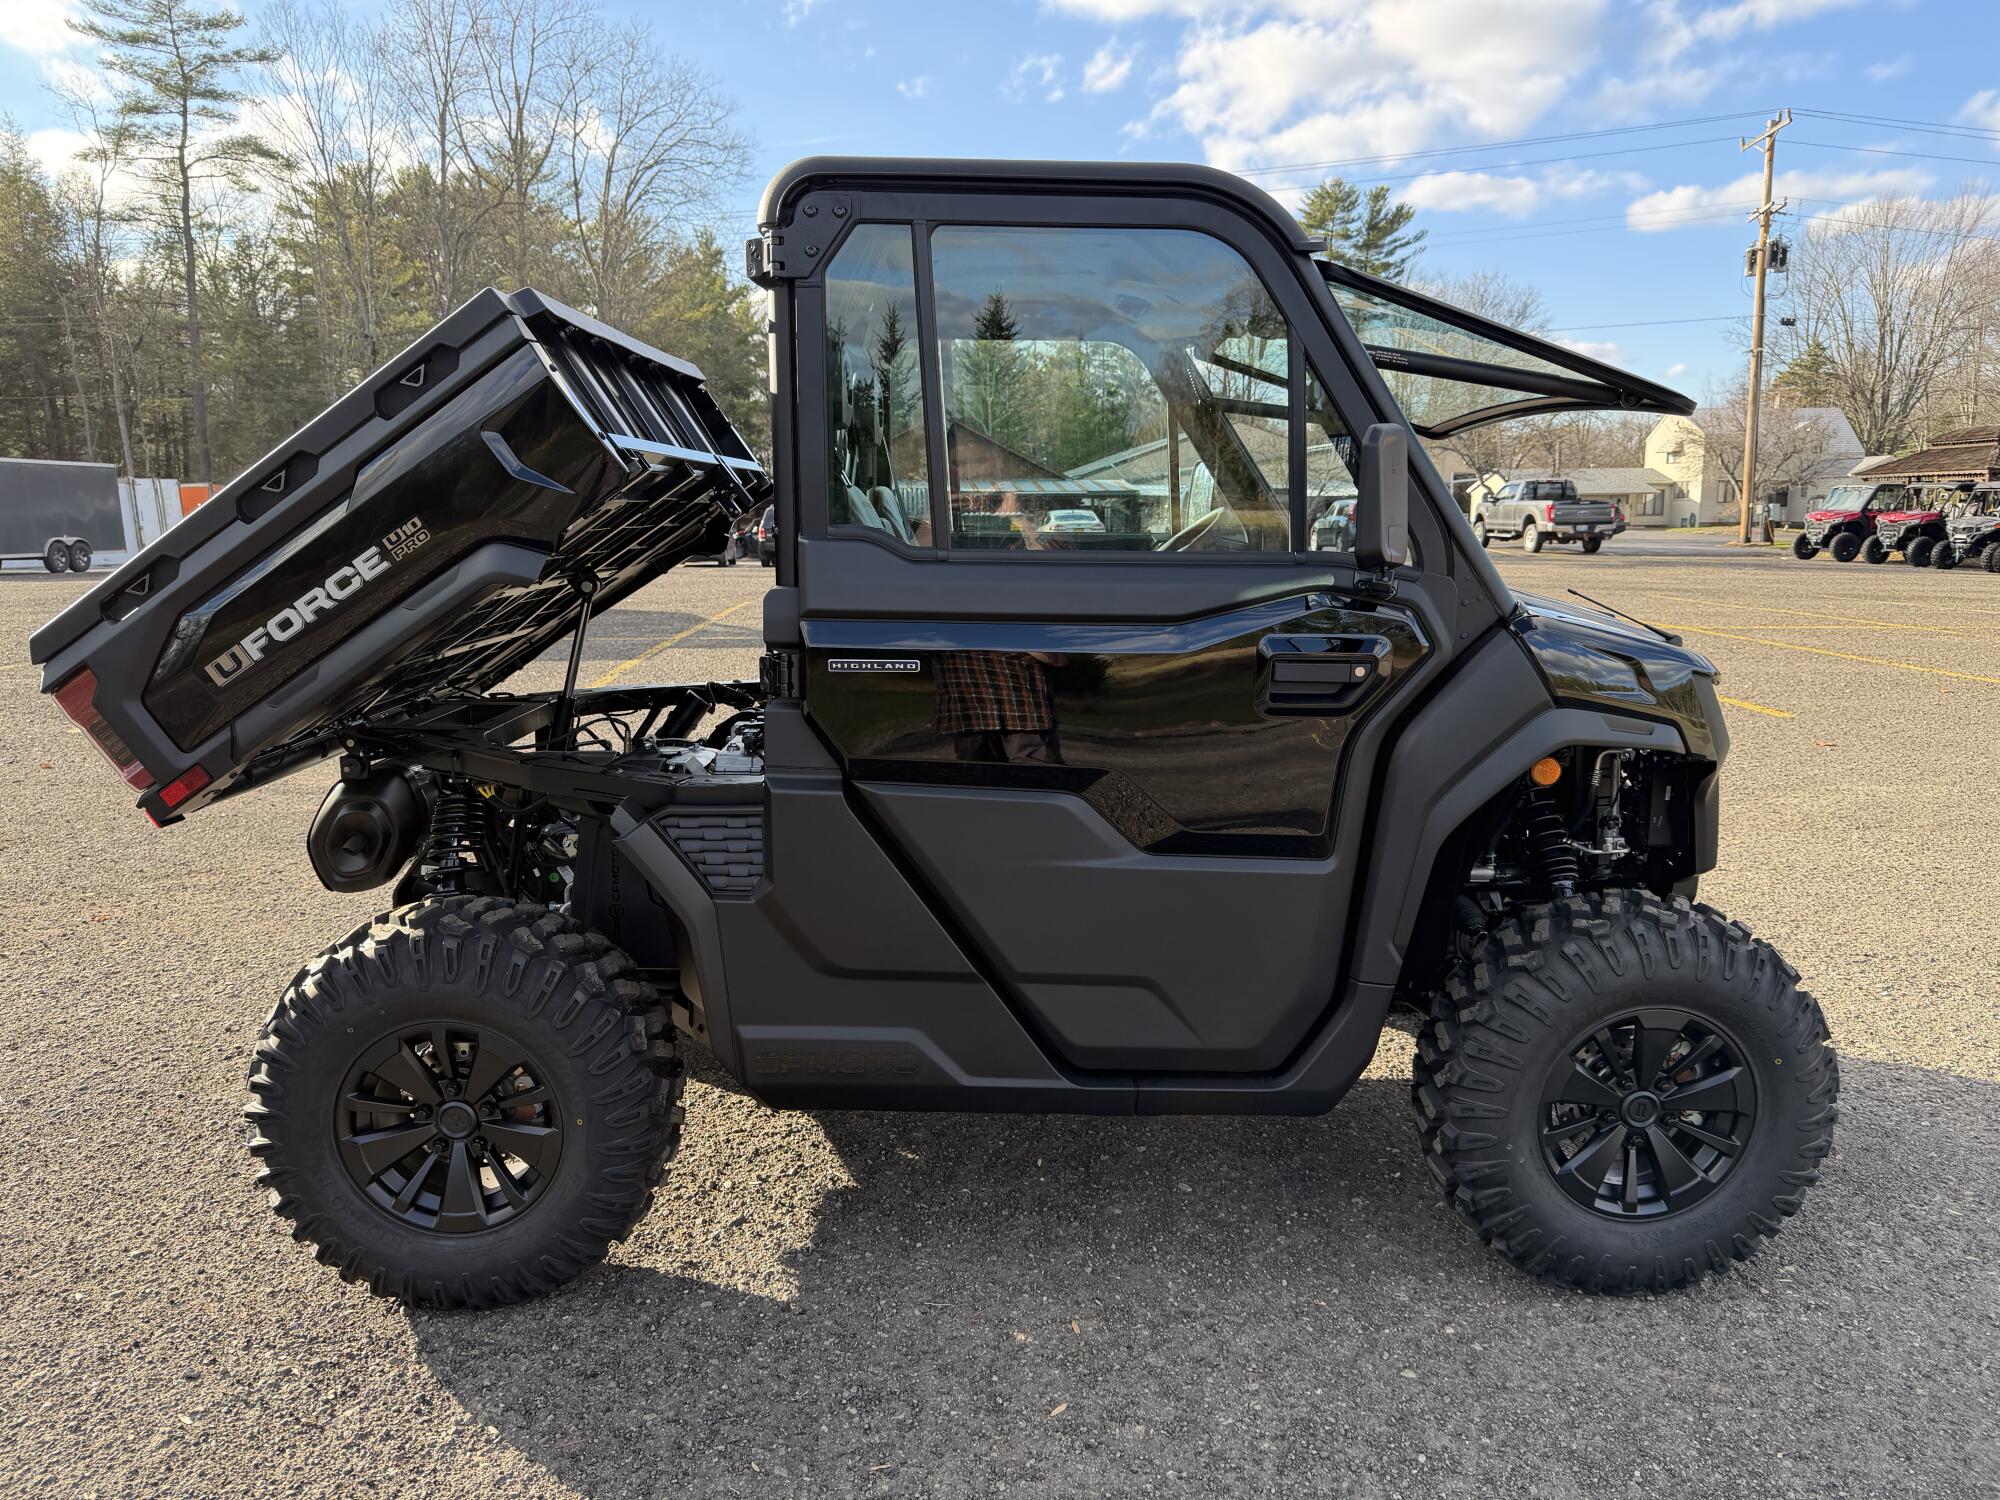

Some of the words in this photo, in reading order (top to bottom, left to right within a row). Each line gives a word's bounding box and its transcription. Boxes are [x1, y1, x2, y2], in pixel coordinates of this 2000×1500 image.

[382, 516, 423, 550] U10
[391, 528, 431, 561] PRO
[204, 545, 391, 687] UFORCE
[611, 847, 621, 902] CFMOTO
